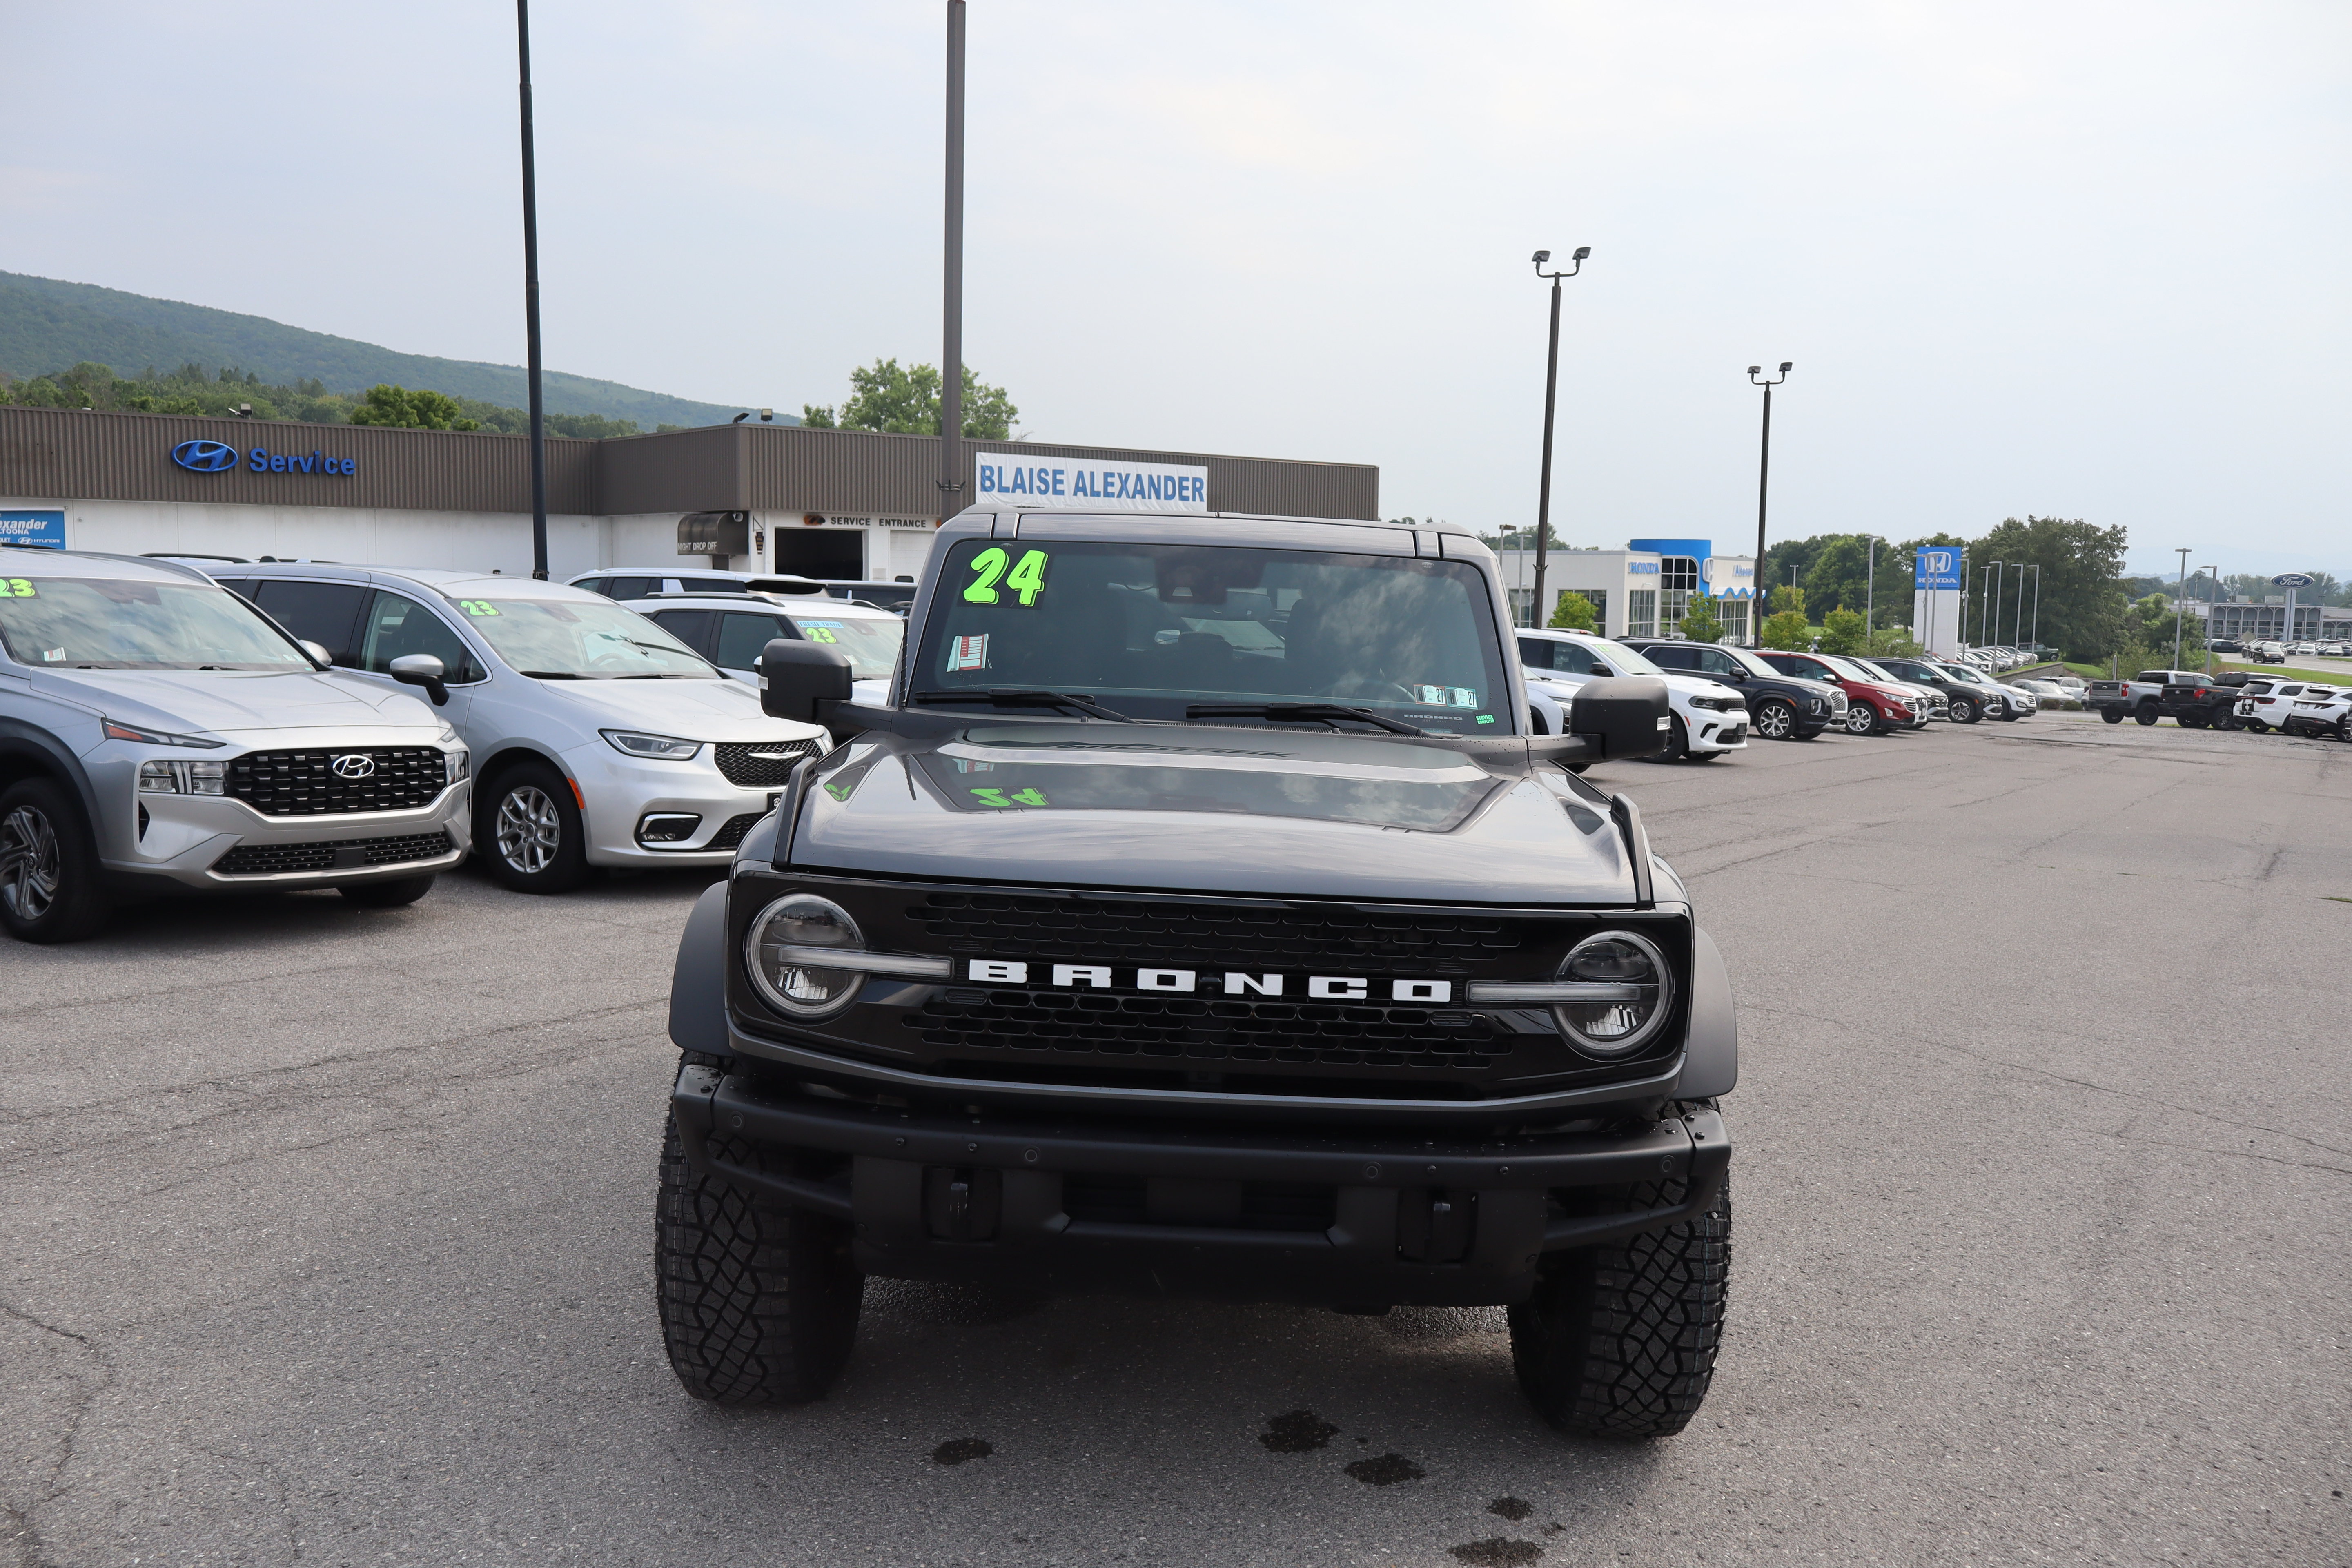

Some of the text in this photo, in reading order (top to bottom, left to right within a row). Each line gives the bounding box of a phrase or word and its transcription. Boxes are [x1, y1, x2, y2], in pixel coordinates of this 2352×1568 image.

[249, 448, 356, 475] Service
[980, 465, 1205, 502] BLAISE ALEXANDER
[831, 517, 927, 528] SERVICE ENTRANCE
[678, 541, 717, 551] NIGHT DROP OFF
[1629, 562, 1660, 574] HONDA
[963, 548, 1049, 607] 24
[2280, 576, 2305, 585] Ford
[0, 578, 36, 597] 23
[460, 600, 499, 615] 23
[806, 627, 837, 644] 23
[1418, 689, 1423, 701] 8
[1436, 688, 1443, 704] 27
[1450, 692, 1455, 705] 8
[1468, 691, 1474, 706] 27
[1056, 745, 1290, 757] WILDTRAK
[969, 959, 1452, 1003] BRONCO
